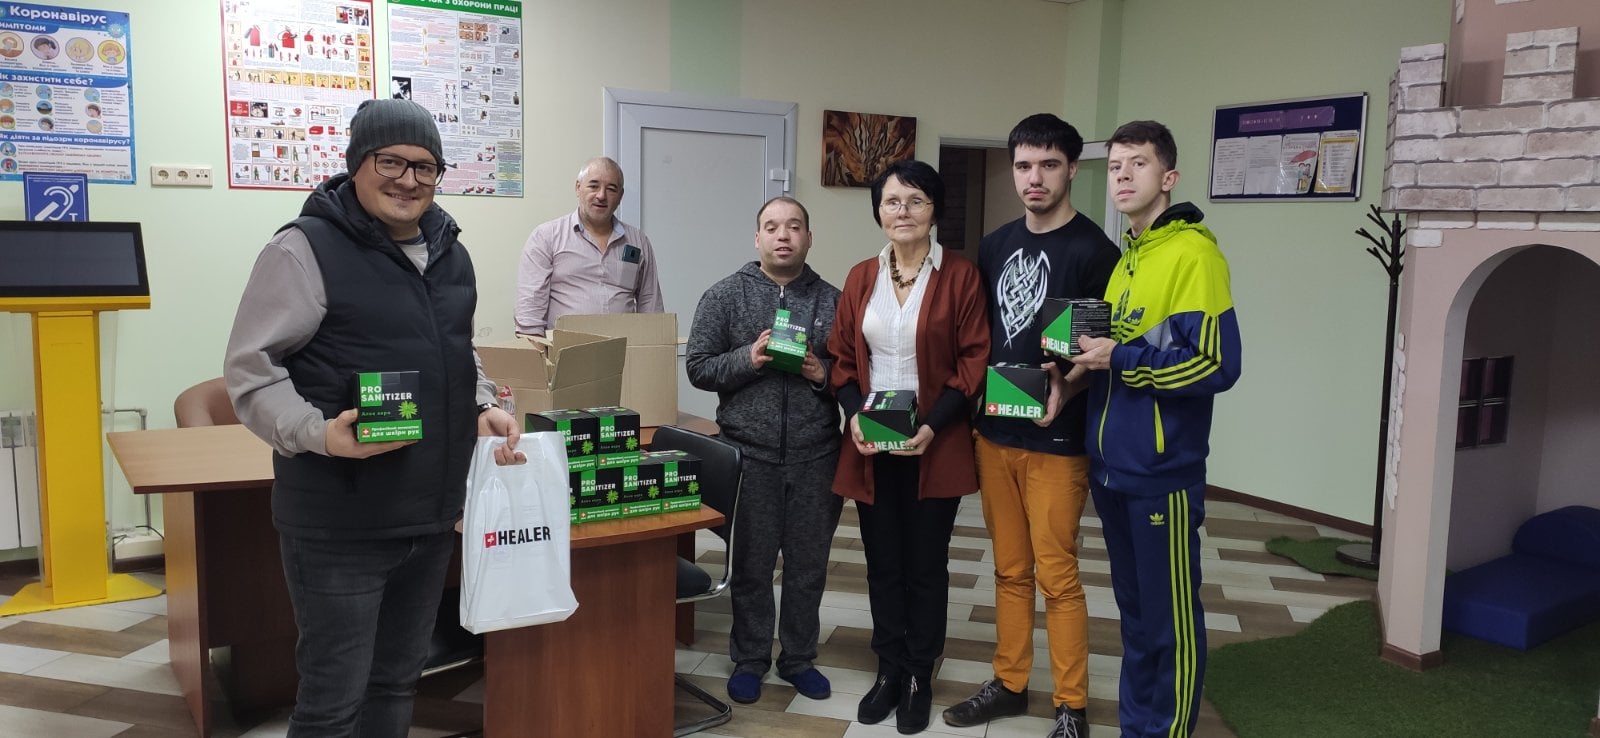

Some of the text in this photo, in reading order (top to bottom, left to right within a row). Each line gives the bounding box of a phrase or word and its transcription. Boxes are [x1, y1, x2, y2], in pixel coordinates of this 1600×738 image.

[452, 0, 492, 9] ОХОРОНИ
[494, 4, 519, 13] ПРАЦІ
[9, 5, 107, 25] Коронавірус
[0, 22, 46, 31] имптоми
[12, 74, 61, 83] захистити
[63, 77, 93, 86] себе?
[1046, 336, 1069, 354] HEALER
[360, 385, 382, 394] PRO
[360, 392, 412, 402] SANITIZER
[997, 403, 1042, 419] HEALER
[600, 425, 615, 433] PRO
[600, 430, 635, 439] SANITIZER
[874, 441, 914, 451] HEALE
[623, 479, 657, 488] SANITIZER
[664, 475, 697, 484] SANITIZER
[581, 484, 616, 493] SANITIZER
[498, 526, 551, 545] HEALER
